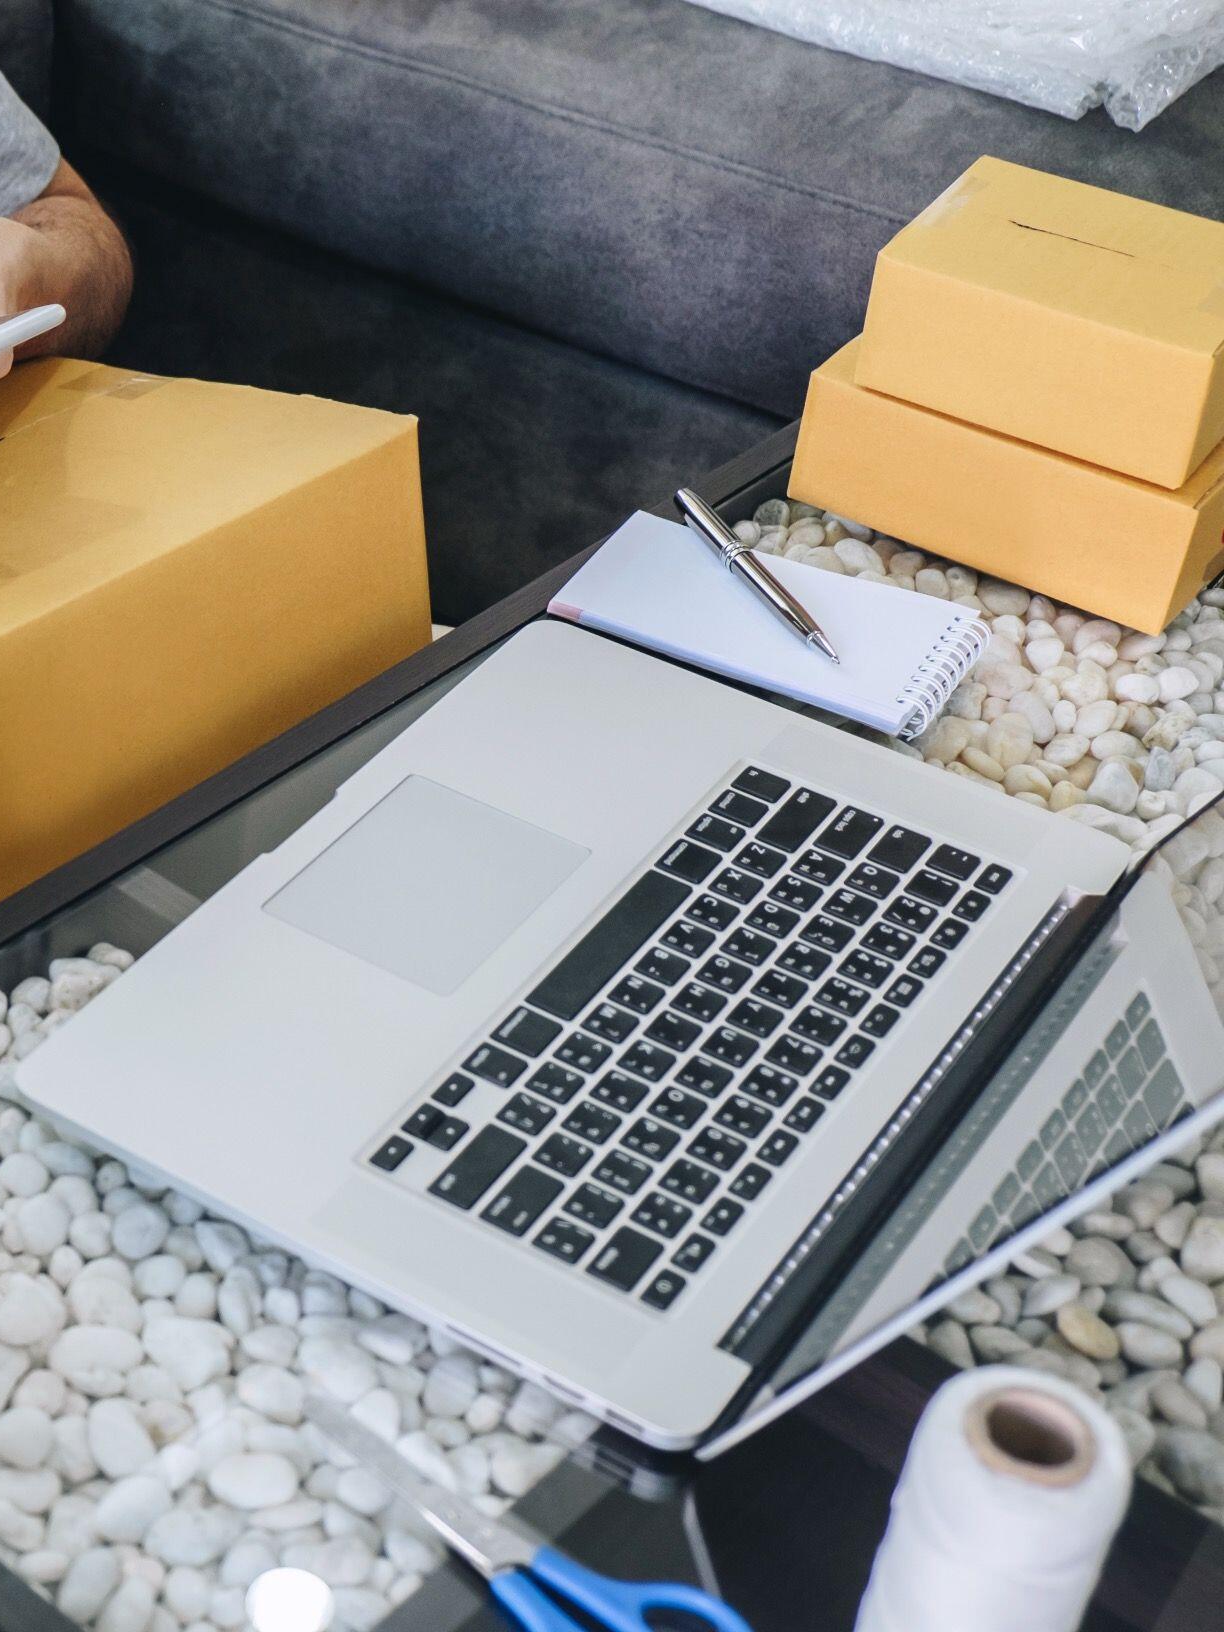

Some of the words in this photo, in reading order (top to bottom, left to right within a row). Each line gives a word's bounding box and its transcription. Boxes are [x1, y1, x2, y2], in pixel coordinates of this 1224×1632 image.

[751, 844, 765, 854] Z
[809, 852, 823, 861] A
[727, 870, 742, 880] X
[863, 866, 878, 875] Q
[788, 877, 801, 886] S
[704, 897, 718, 906] C
[840, 892, 856, 903] W
[764, 903, 778, 913] D
[902, 899, 915, 907] 2
[819, 917, 834, 926] E
[680, 924, 694, 933] V
[880, 925, 893, 934] 3
[742, 930, 755, 939] F
[796, 944, 810, 954] R
[857, 953, 870, 961] 4
[715, 958, 730, 968] G
[773, 973, 787, 982] T
[628, 977, 643, 989] N
[833, 979, 847, 989] 5
[690, 985, 705, 996] H
[747, 1002, 762, 1012] Y
[721, 1029, 737, 1041] U
[786, 1038, 800, 1048] 7
[638, 1043, 654, 1054] K
